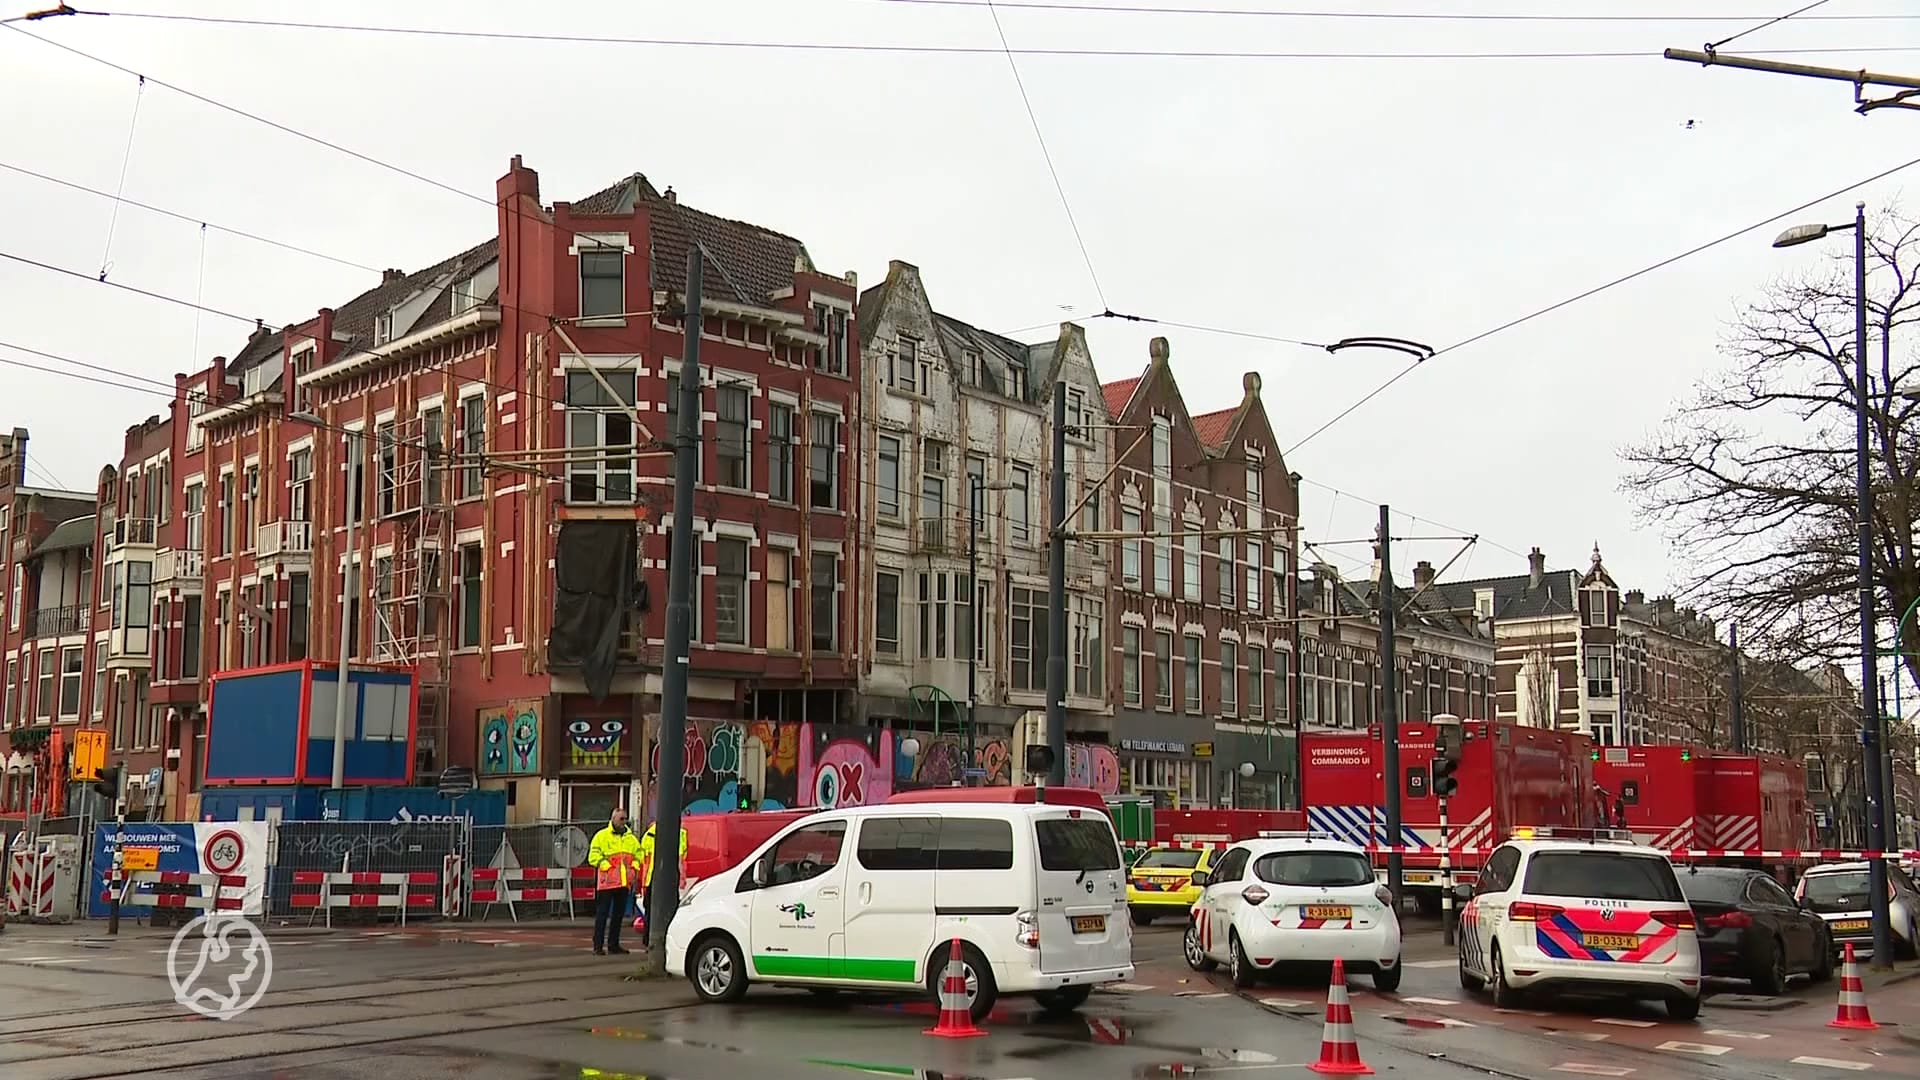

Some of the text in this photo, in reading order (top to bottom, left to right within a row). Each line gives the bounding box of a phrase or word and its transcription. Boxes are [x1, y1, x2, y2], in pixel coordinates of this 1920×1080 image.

[1311, 748, 1366, 756] VERBINDINGS-
[1311, 757, 1360, 765] COMMANDO
[1584, 899, 1629, 908] POLITIE
[1586, 935, 1633, 947] JB-033-K
